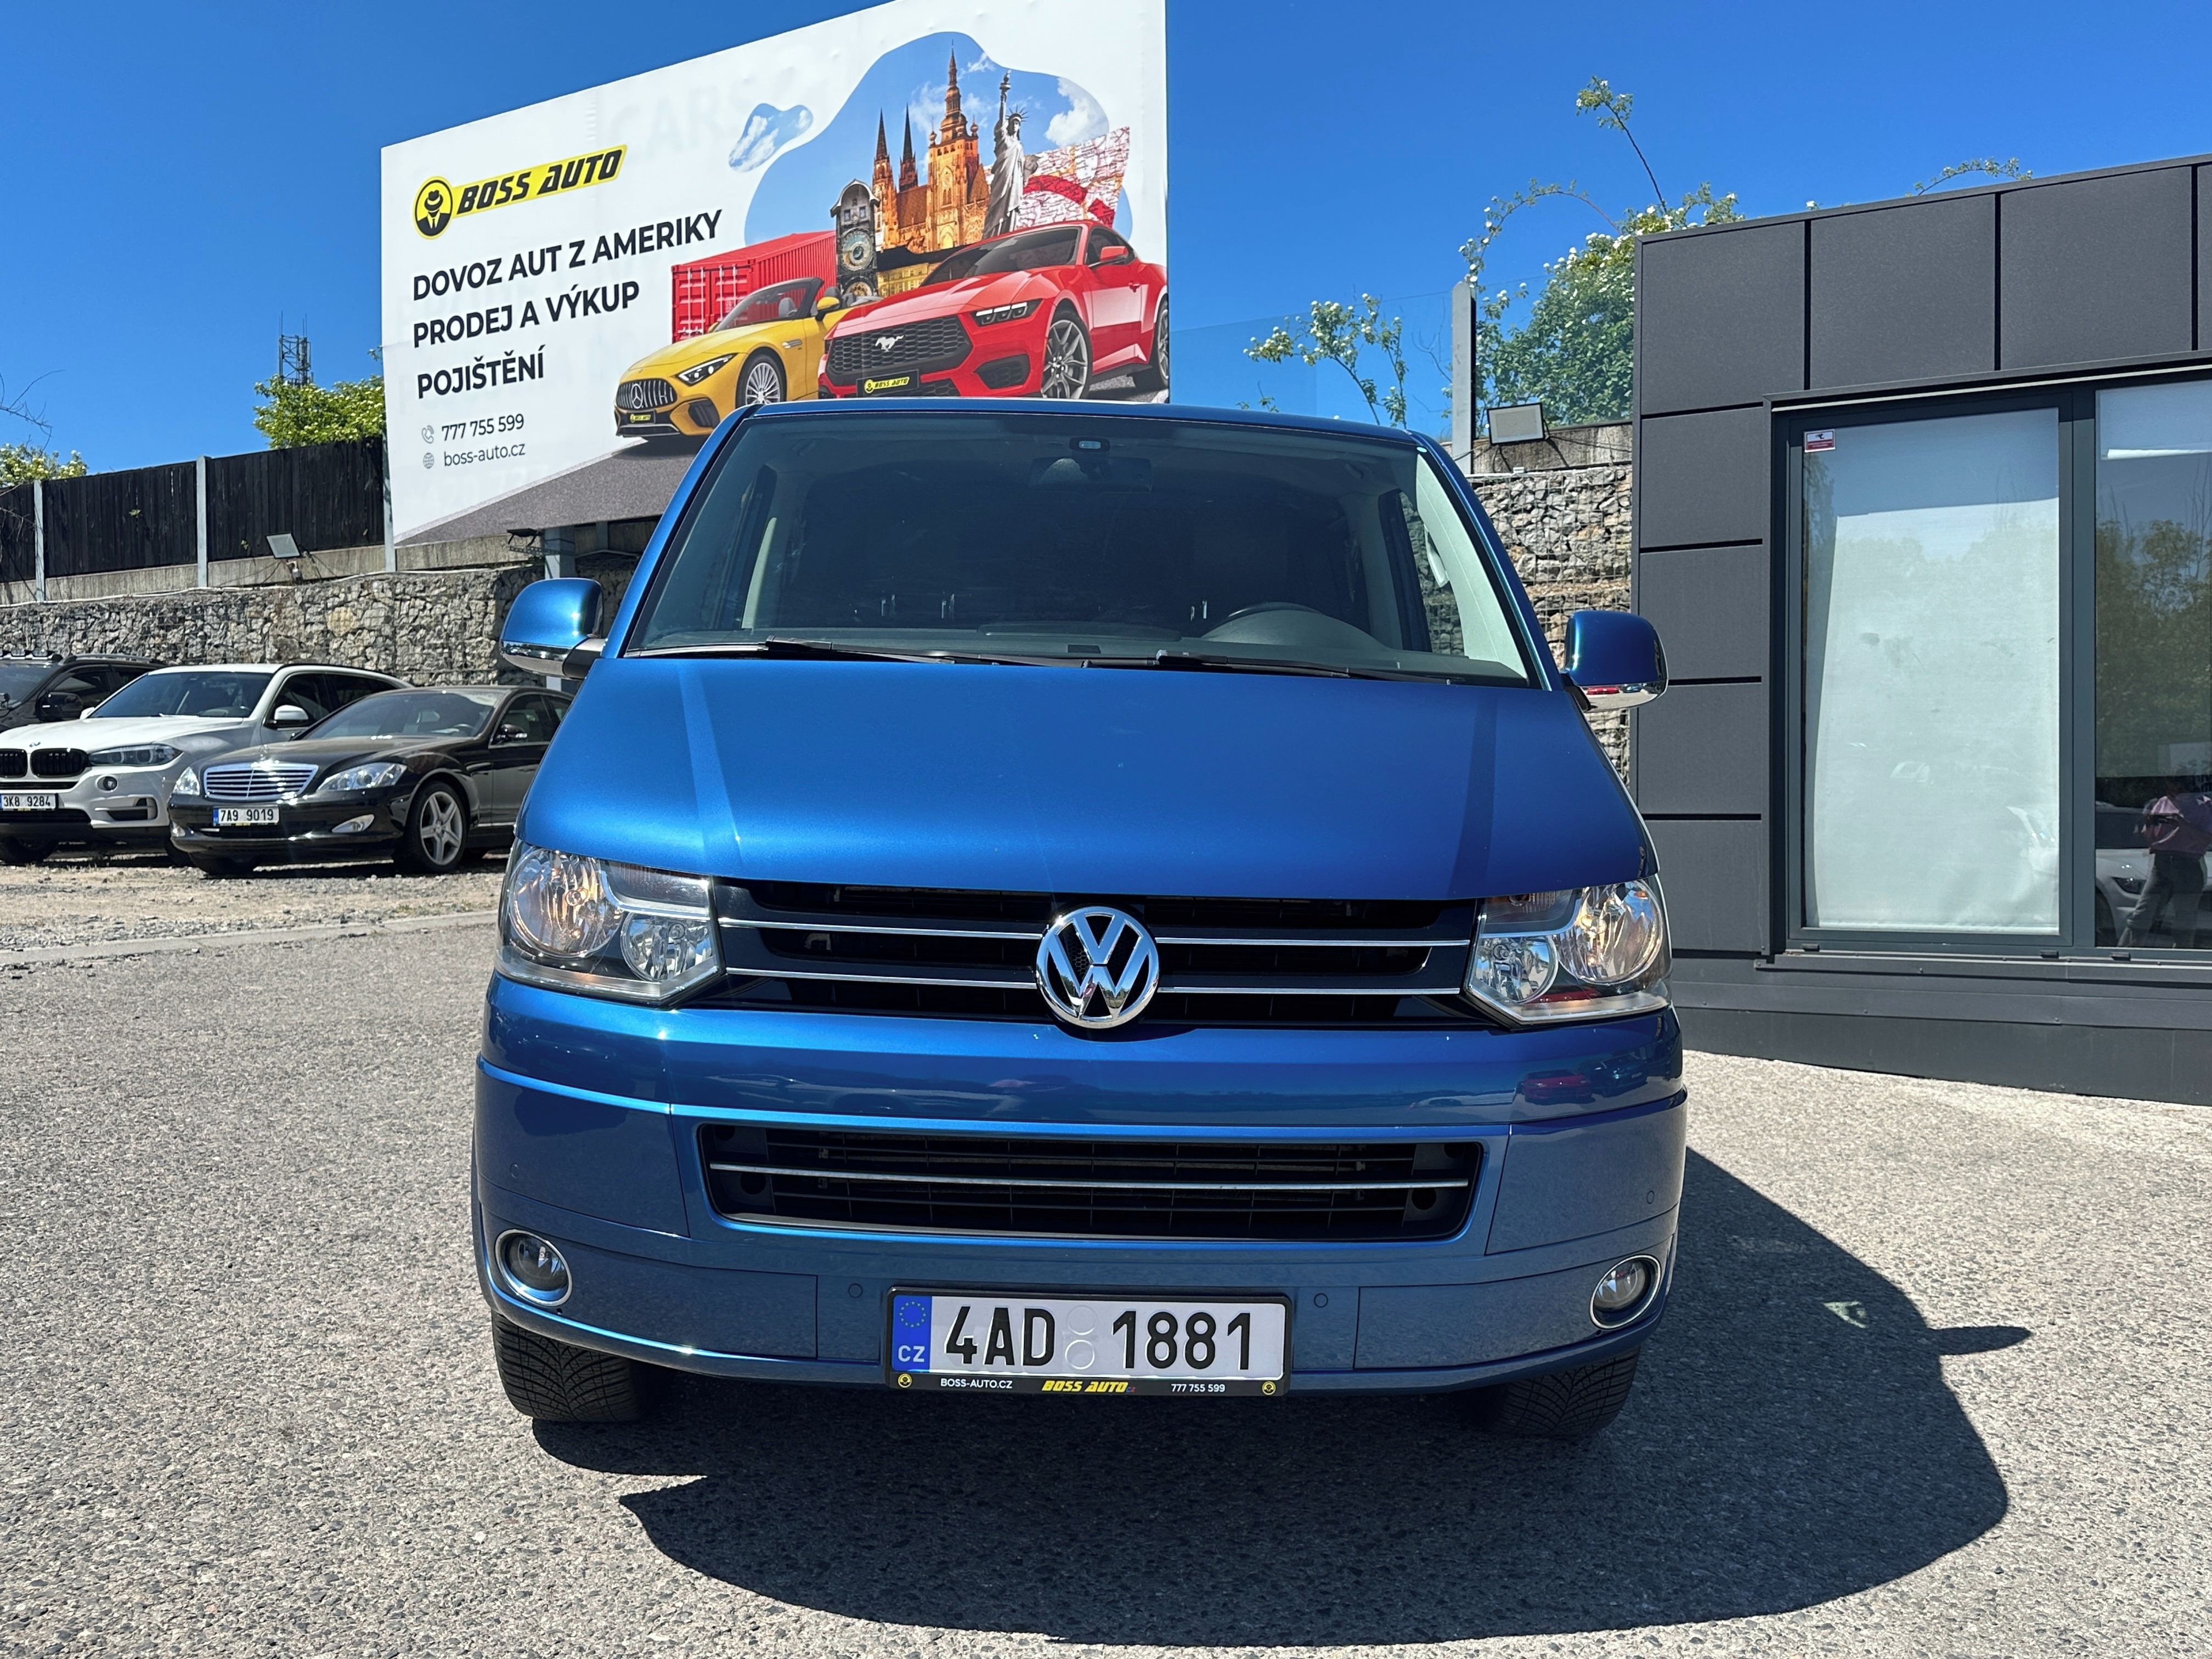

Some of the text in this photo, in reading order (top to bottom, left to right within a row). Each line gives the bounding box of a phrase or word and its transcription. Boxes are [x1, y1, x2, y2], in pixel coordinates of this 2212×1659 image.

[456, 149, 623, 215] BOSS AUTO
[414, 209, 722, 301] DOVOZ AUT Z AMERIKY
[414, 281, 640, 348] PRODEJ A VÝKUP
[417, 345, 546, 399] POJIŠTĚNÍ
[442, 413, 524, 441] 777 755 599
[444, 443, 526, 467] boss-auto.cz
[3, 795, 50, 807] 3K8 9284
[221, 809, 274, 822] 7A9 9019
[945, 1306, 1251, 1370] 4AD 1881
[898, 1345, 925, 1363] CZ
[940, 1378, 1013, 1389] BOSS-AUTO.CZ
[1041, 1380, 1084, 1391] BOSS
[1084, 1381, 1128, 1393] AUTO
[1171, 1384, 1226, 1392] 777 755 599
